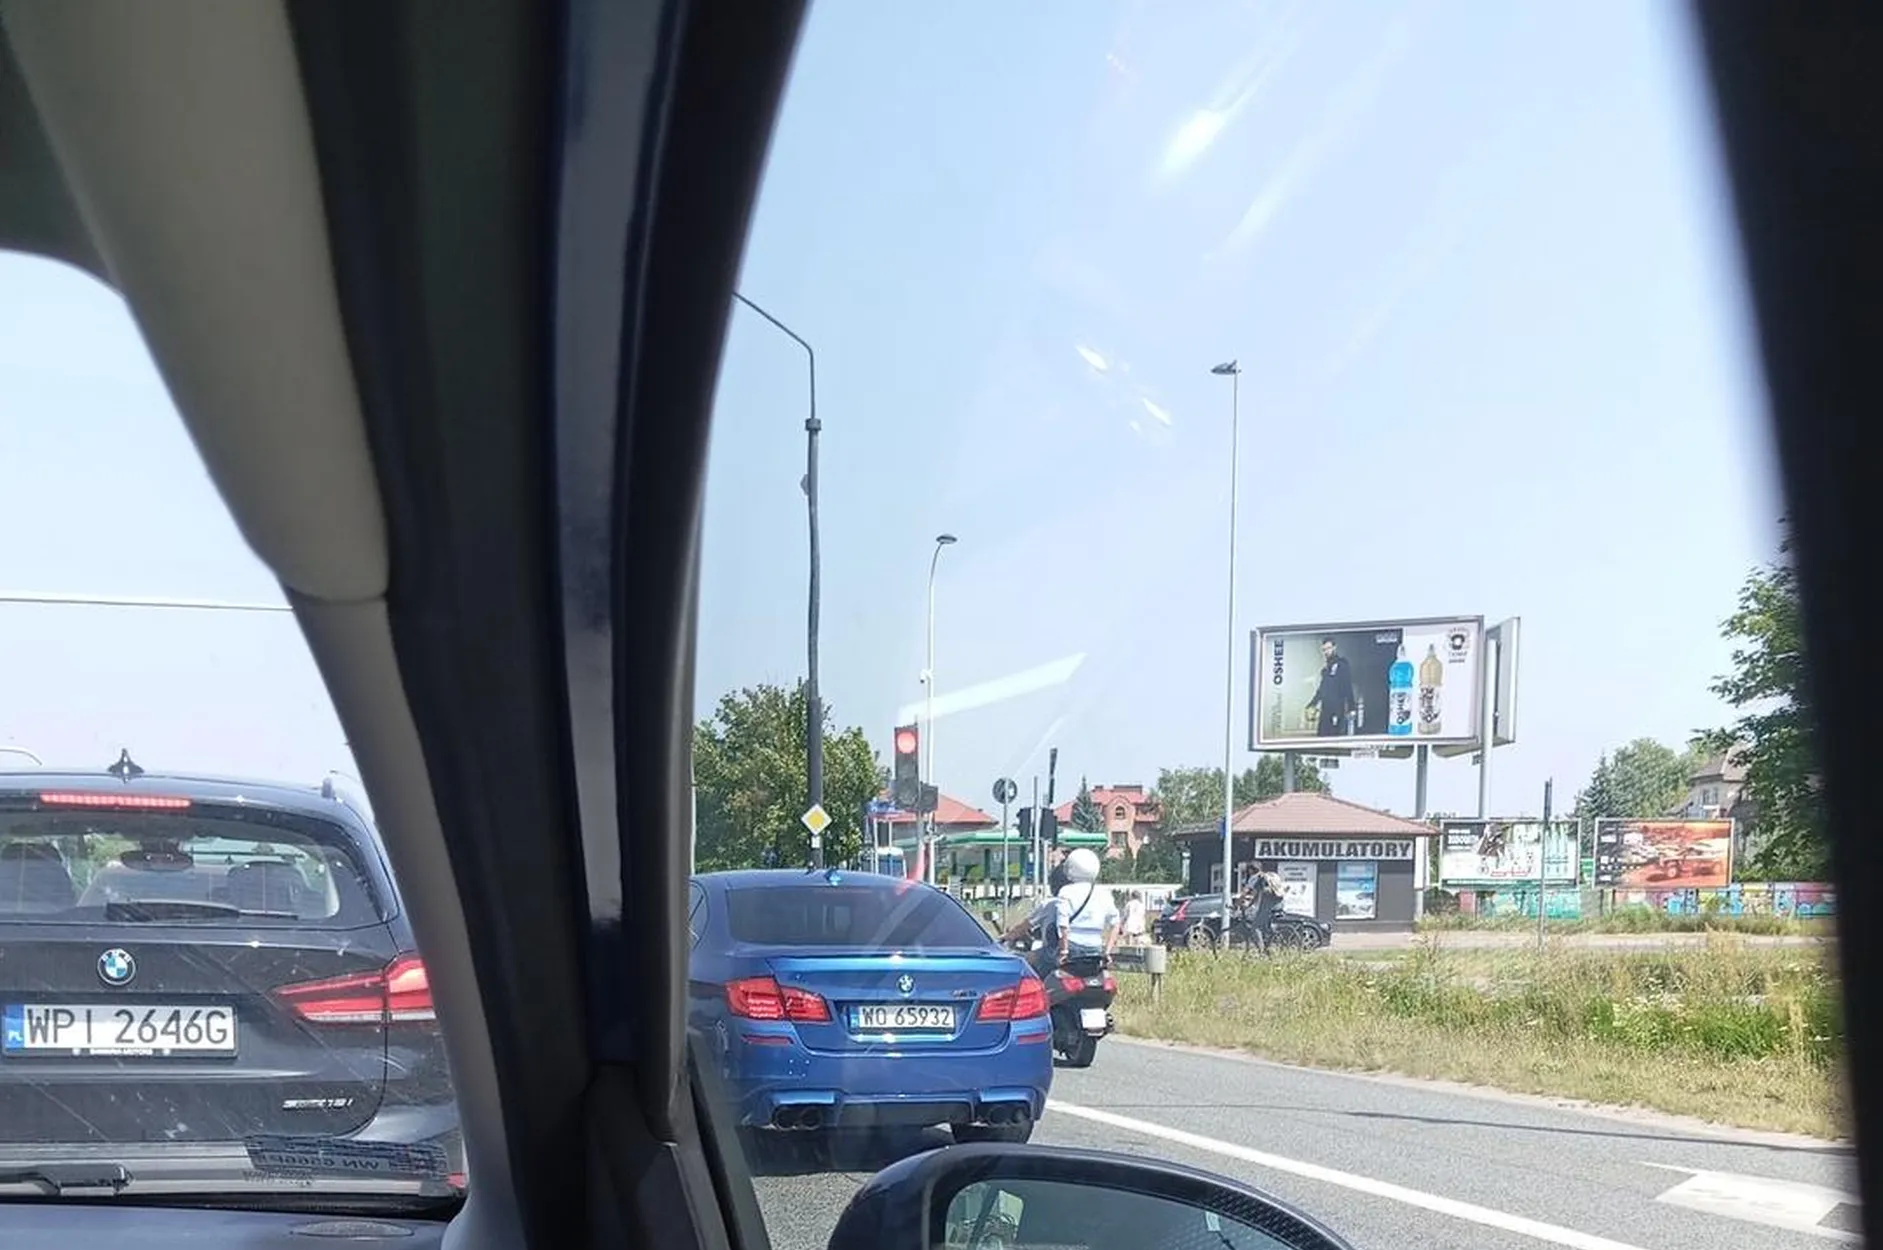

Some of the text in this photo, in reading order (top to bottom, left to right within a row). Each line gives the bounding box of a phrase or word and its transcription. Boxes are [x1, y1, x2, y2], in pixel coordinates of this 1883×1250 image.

[1273, 640, 1284, 685] OSHEE
[1258, 841, 1411, 858] AKUMULATORY
[27, 1008, 227, 1044] WPI 2646G
[862, 1007, 951, 1026] WO 65932
